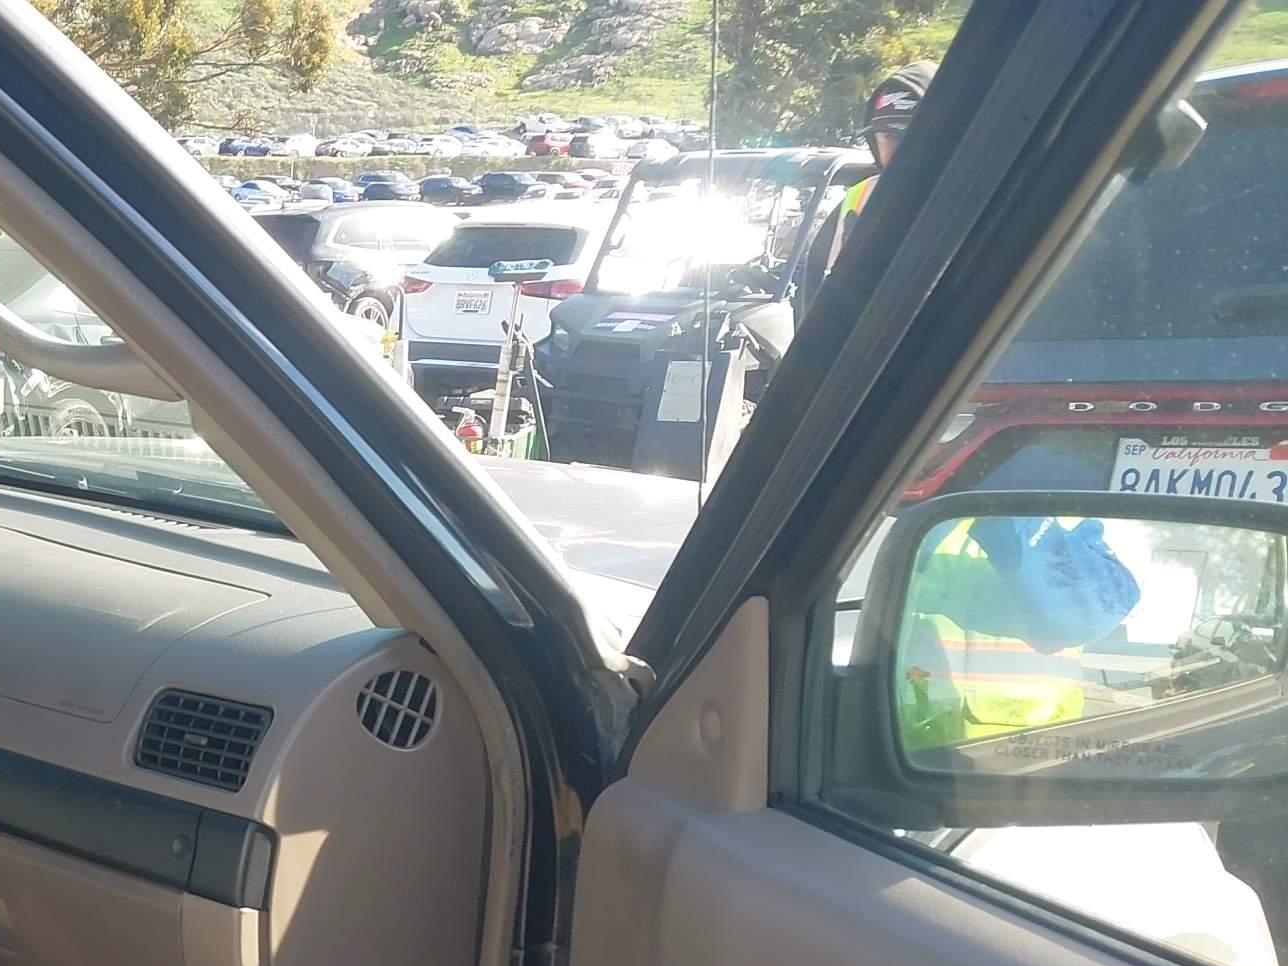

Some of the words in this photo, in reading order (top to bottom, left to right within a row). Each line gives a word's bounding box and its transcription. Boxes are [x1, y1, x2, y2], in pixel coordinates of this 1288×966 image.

[1162, 436, 1188, 446] LOS
[1124, 444, 1146, 456] SEP
[1152, 447, 1259, 467] California
[994, 744, 1048, 759] CLOSER
